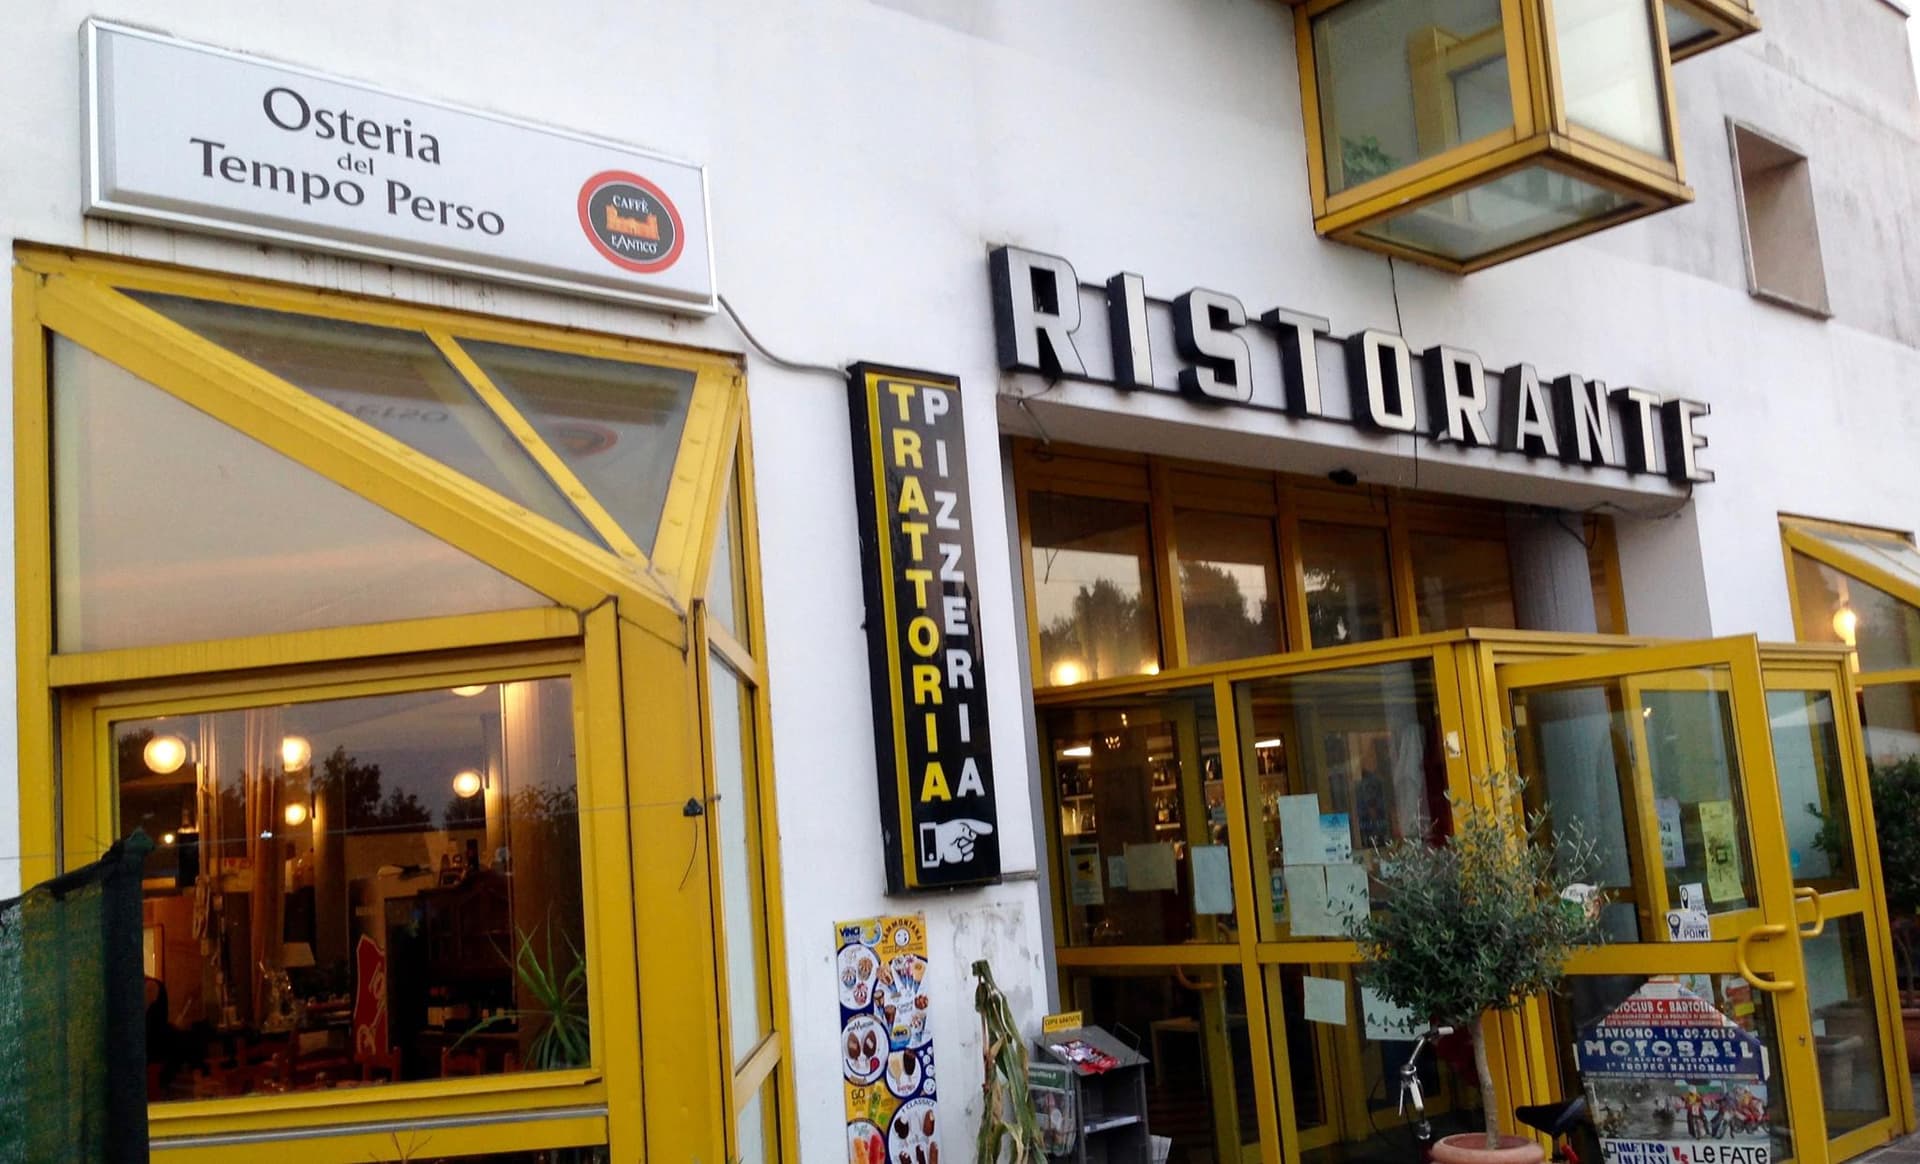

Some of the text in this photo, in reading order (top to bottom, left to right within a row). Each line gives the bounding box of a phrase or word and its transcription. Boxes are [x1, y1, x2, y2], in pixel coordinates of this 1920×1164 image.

[262, 86, 441, 165] Osteria
[337, 152, 375, 176] del
[189, 138, 505, 236] Tempo Perso
[990, 243, 1715, 482] RISTORANTE
[889, 383, 951, 803] TRATTORIA
[923, 387, 985, 798] PIZZERIA
[1584, 1040, 1753, 1058] MOTOBALL
[1671, 1063, 1736, 1073] NAZIONALE
